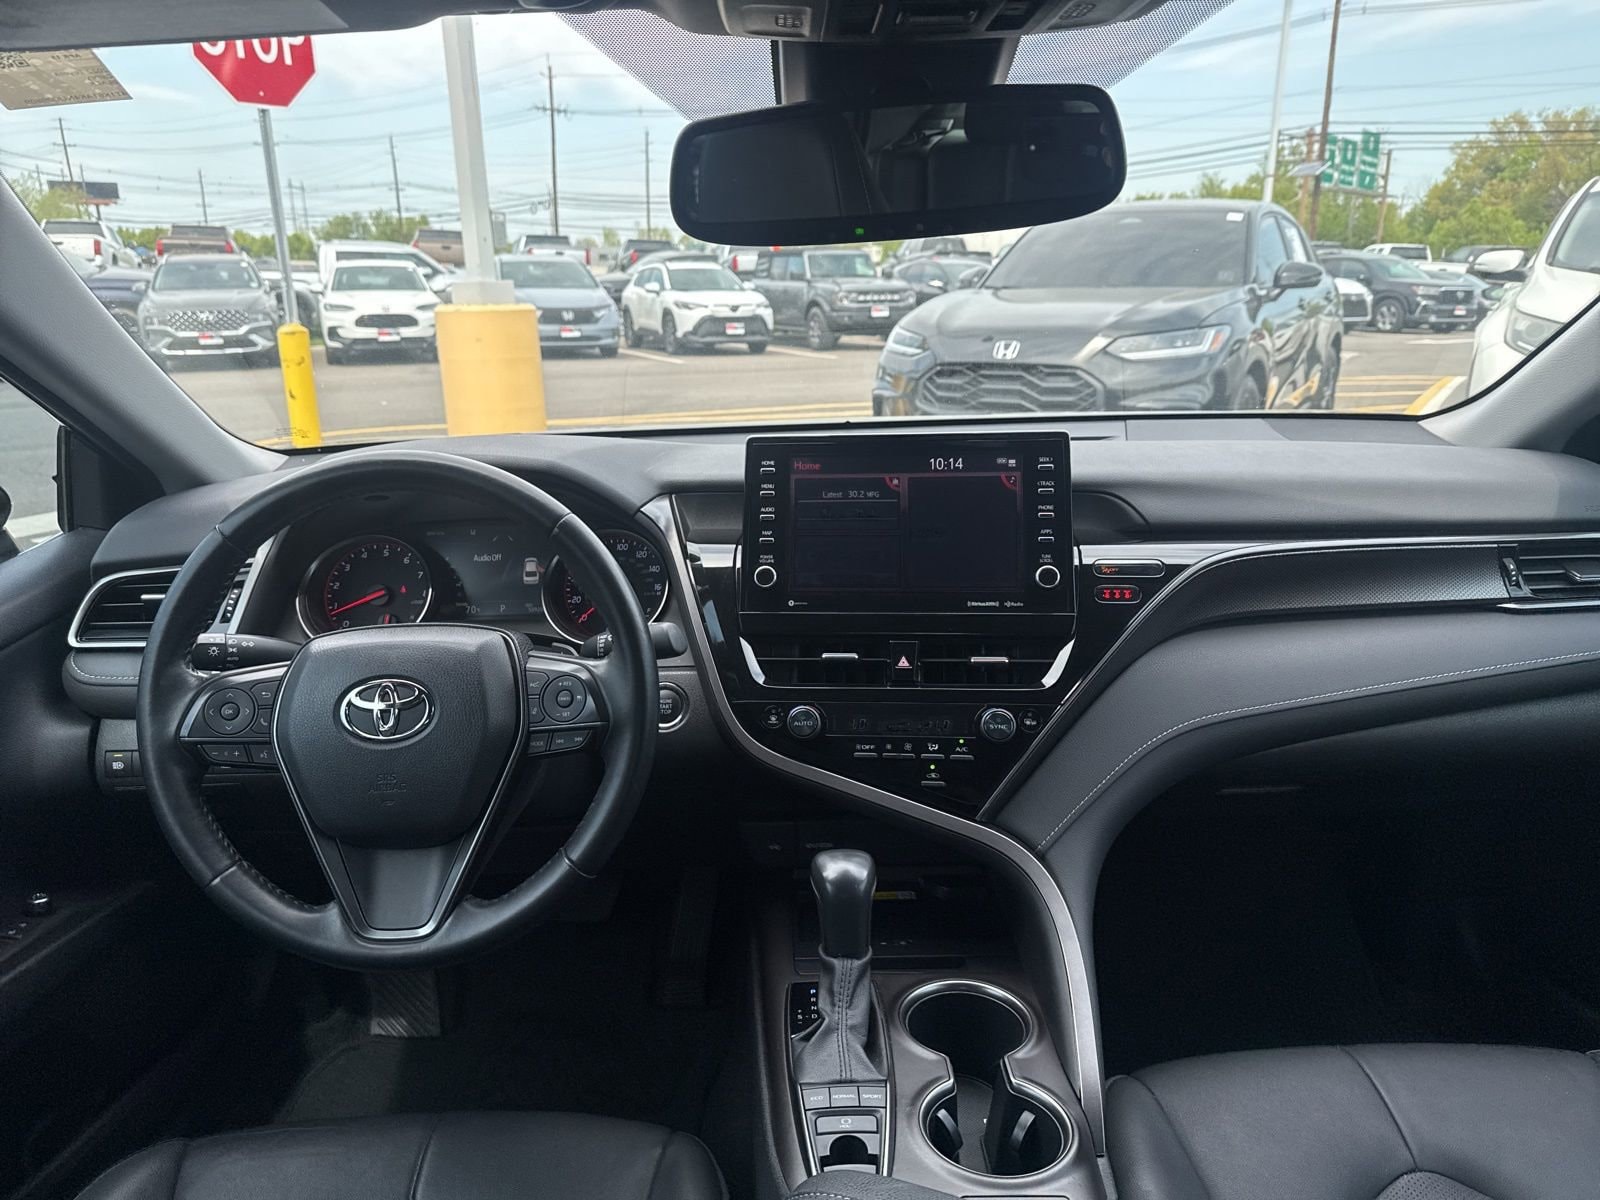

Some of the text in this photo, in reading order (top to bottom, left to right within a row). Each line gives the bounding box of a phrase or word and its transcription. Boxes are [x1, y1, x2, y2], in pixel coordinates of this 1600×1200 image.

[794, 461, 821, 471] Home
[929, 458, 963, 470] 10:14
[848, 490, 865, 498] 30.2
[383, 549, 389, 557] 5
